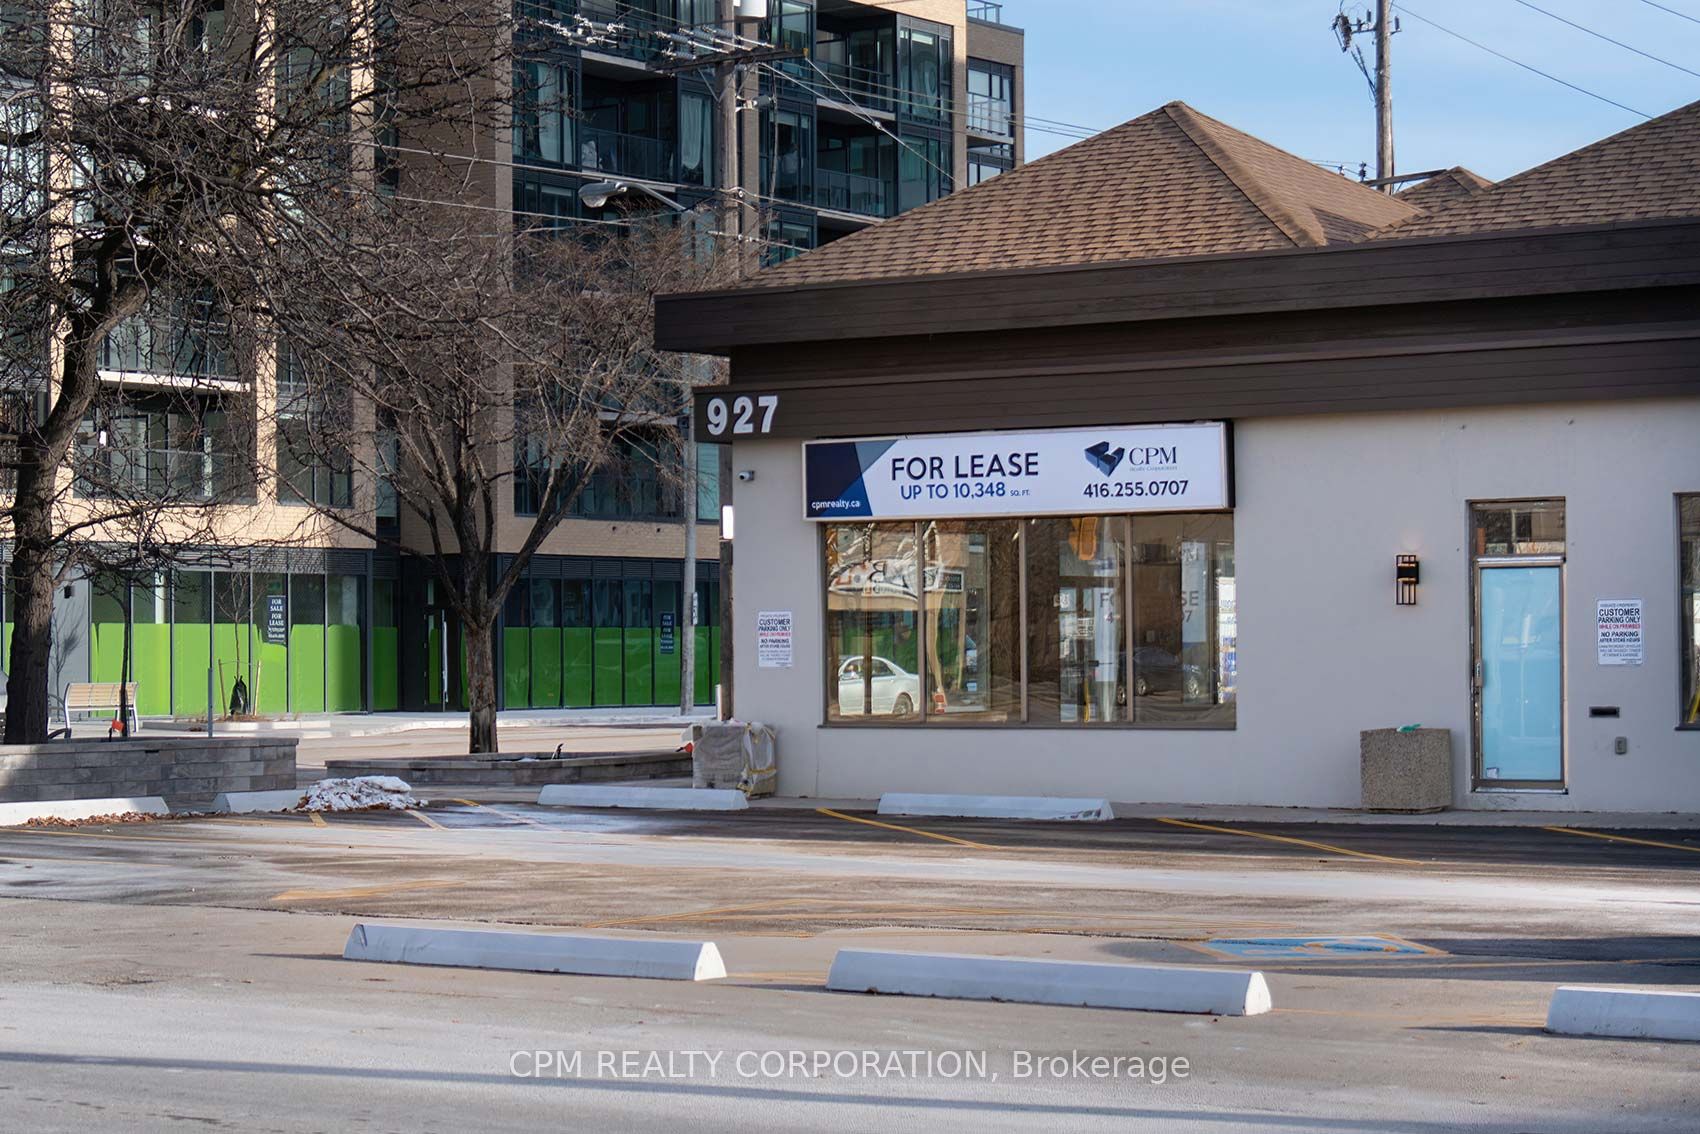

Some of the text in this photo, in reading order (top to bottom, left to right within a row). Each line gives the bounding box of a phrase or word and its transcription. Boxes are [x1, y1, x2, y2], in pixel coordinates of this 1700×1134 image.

[707, 395, 778, 436] 927
[1128, 446, 1177, 466] CPM
[891, 452, 1039, 481] FOR LEASE
[900, 484, 922, 500] UP
[926, 483, 949, 499] TO
[953, 481, 1006, 499] 10,348
[1083, 480, 1189, 498] 416.255.0707
[811, 499, 861, 510] cpmrealty.ca
[1599, 608, 1640, 616] CUSTOMER
